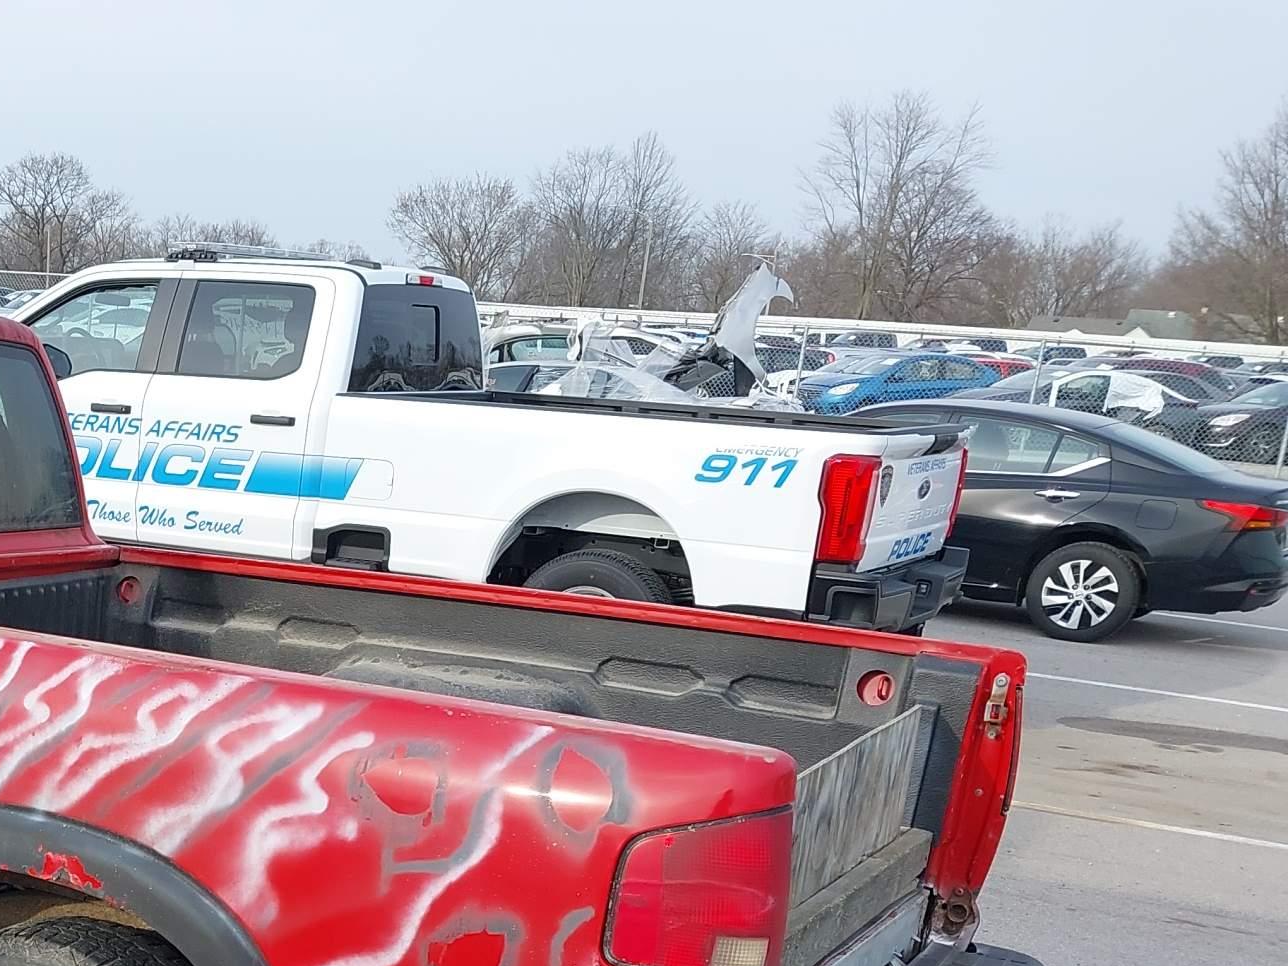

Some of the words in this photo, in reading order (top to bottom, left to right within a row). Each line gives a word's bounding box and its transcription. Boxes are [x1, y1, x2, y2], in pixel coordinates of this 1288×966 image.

[146, 419, 243, 443] AFFAIRS
[694, 454, 800, 488] 911
[87, 499, 132, 523] Those
[138, 505, 176, 527] Who
[183, 510, 244, 535] Served
[888, 532, 932, 561] POLICE
